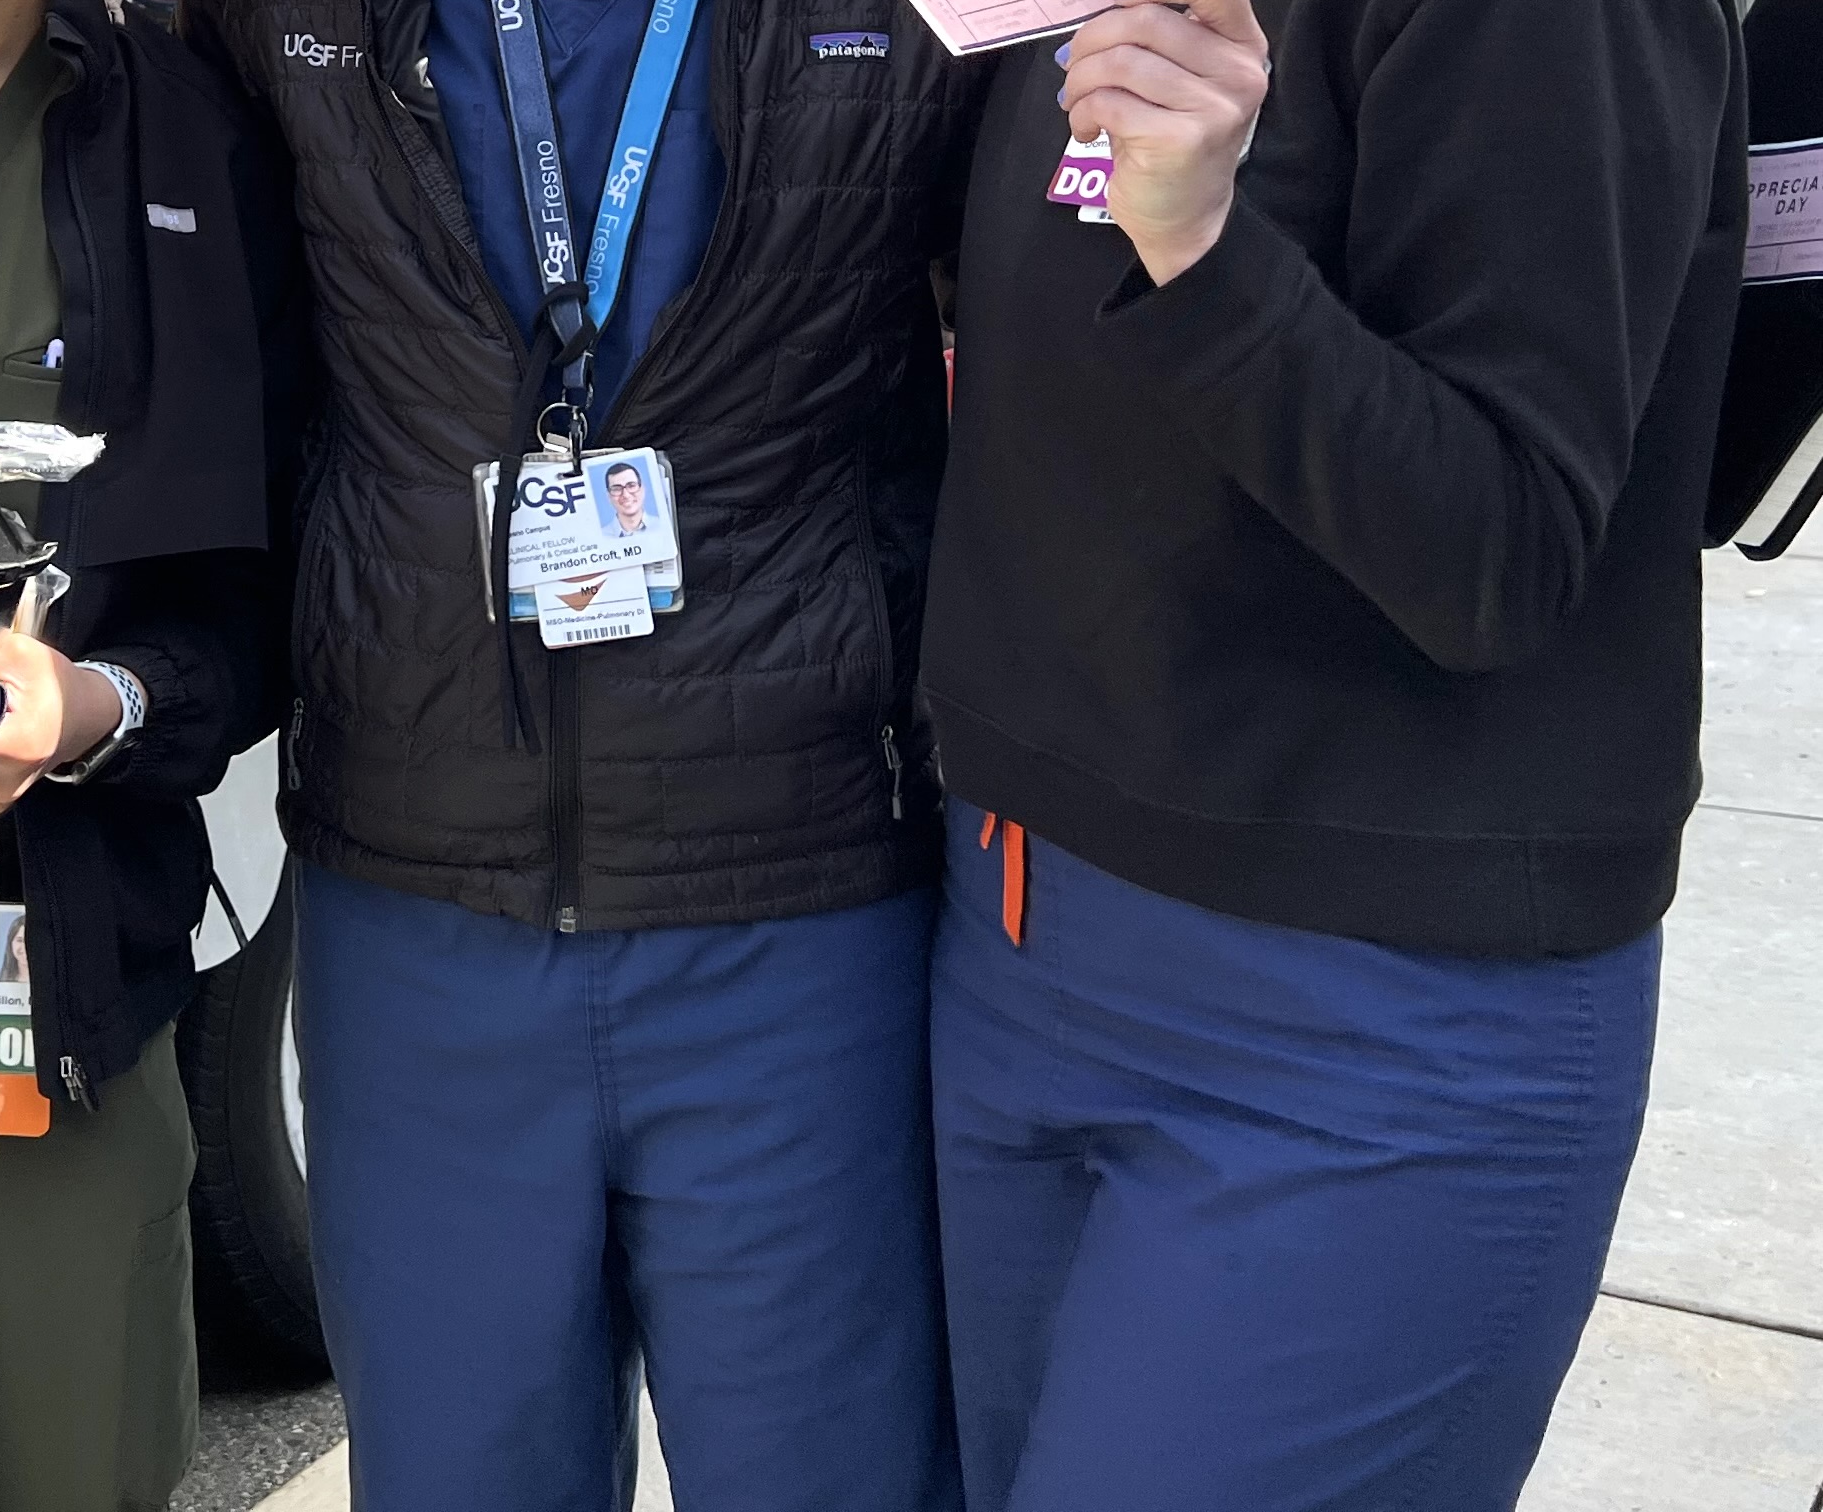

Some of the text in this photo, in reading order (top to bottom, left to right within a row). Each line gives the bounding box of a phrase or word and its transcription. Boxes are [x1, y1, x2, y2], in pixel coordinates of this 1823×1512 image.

[283, 33, 338, 67] UCSF
[818, 45, 886, 59] patagonia
[536, 140, 564, 224] Fresno
[1053, 166, 1109, 200] DO
[1775, 196, 1809, 216] DAY
[588, 146, 648, 296] UCSF Fresno
[542, 536, 576, 548] FELLOW
[580, 543, 598, 552] Care
[540, 545, 642, 573] Brandon Croft, MD
[580, 585, 599, 597] MD
